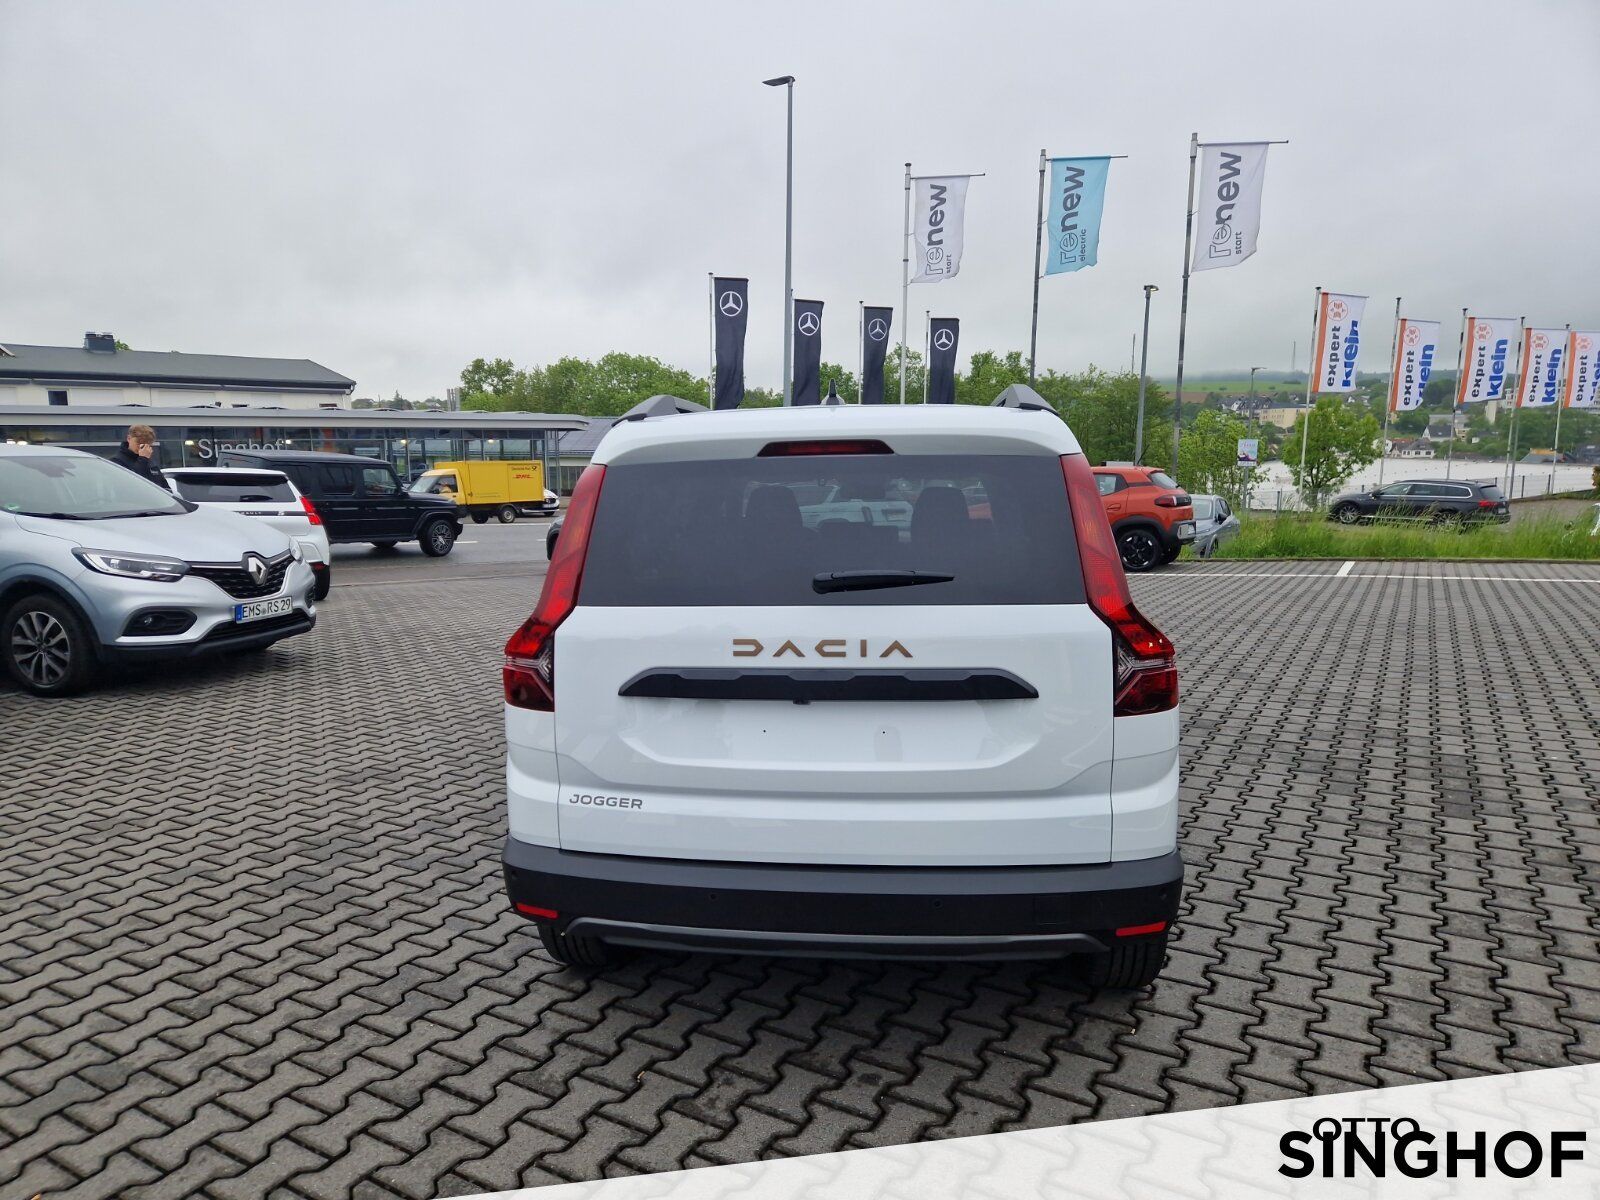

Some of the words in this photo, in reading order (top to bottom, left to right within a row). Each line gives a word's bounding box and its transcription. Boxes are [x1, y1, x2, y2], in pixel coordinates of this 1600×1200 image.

[925, 183, 947, 275] renew
[1060, 166, 1085, 264] renew
[1209, 152, 1242, 259] renew
[1079, 228, 1087, 262] electric
[1326, 325, 1341, 387] expert
[1403, 350, 1415, 406] expert
[1471, 345, 1486, 398] expert
[1487, 339, 1508, 397] klein
[1528, 354, 1542, 402] expert
[1541, 348, 1562, 403] klein
[1575, 354, 1588, 402] expert
[242, 603, 261, 618] EMS
[267, 601, 279, 614] RS
[280, 598, 291, 611] 29
[732, 638, 914, 658] DACIA
[569, 794, 643, 809] JOGGER
